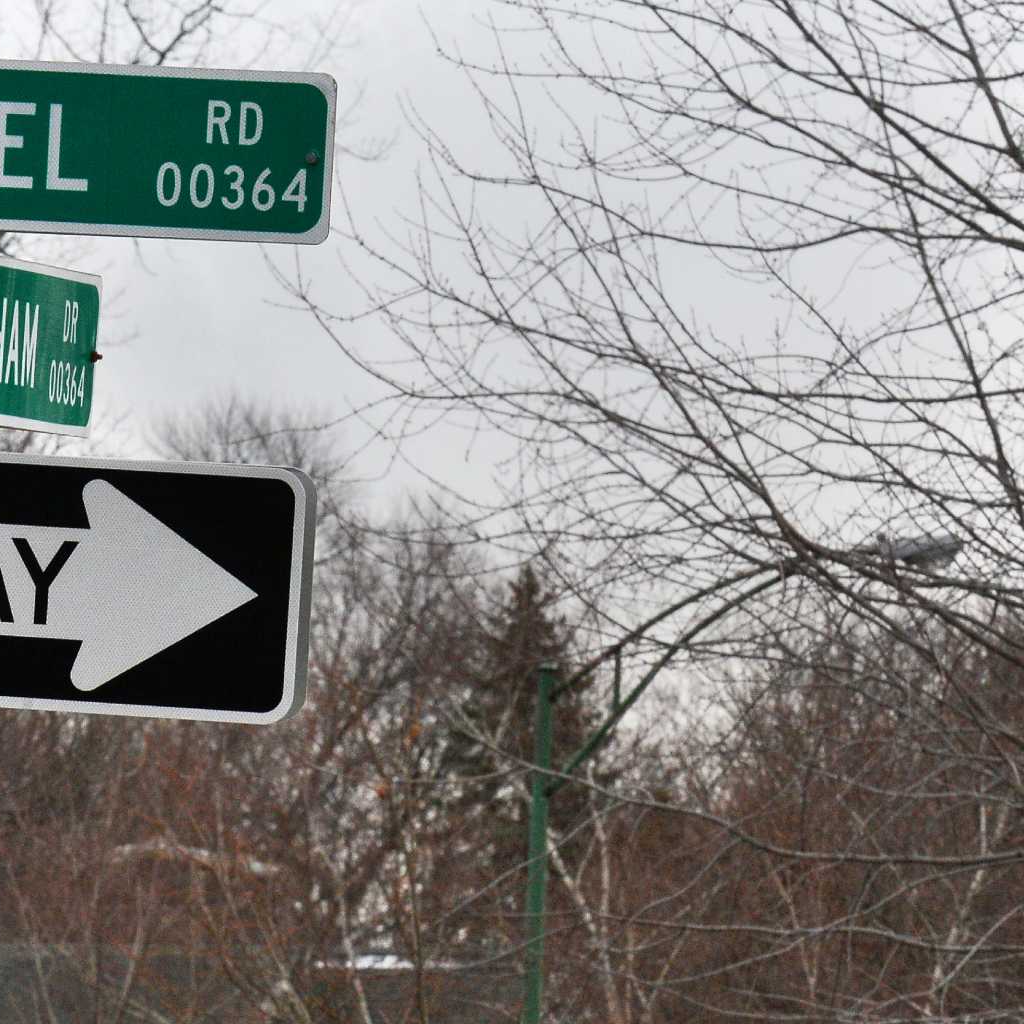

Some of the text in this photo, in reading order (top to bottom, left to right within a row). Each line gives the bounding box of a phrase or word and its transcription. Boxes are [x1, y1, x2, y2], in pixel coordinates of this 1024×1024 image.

[205, 99, 264, 146] RD
[156, 161, 308, 213] 00364
[63, 299, 79, 345] DR
[48, 359, 86, 408] 00364
